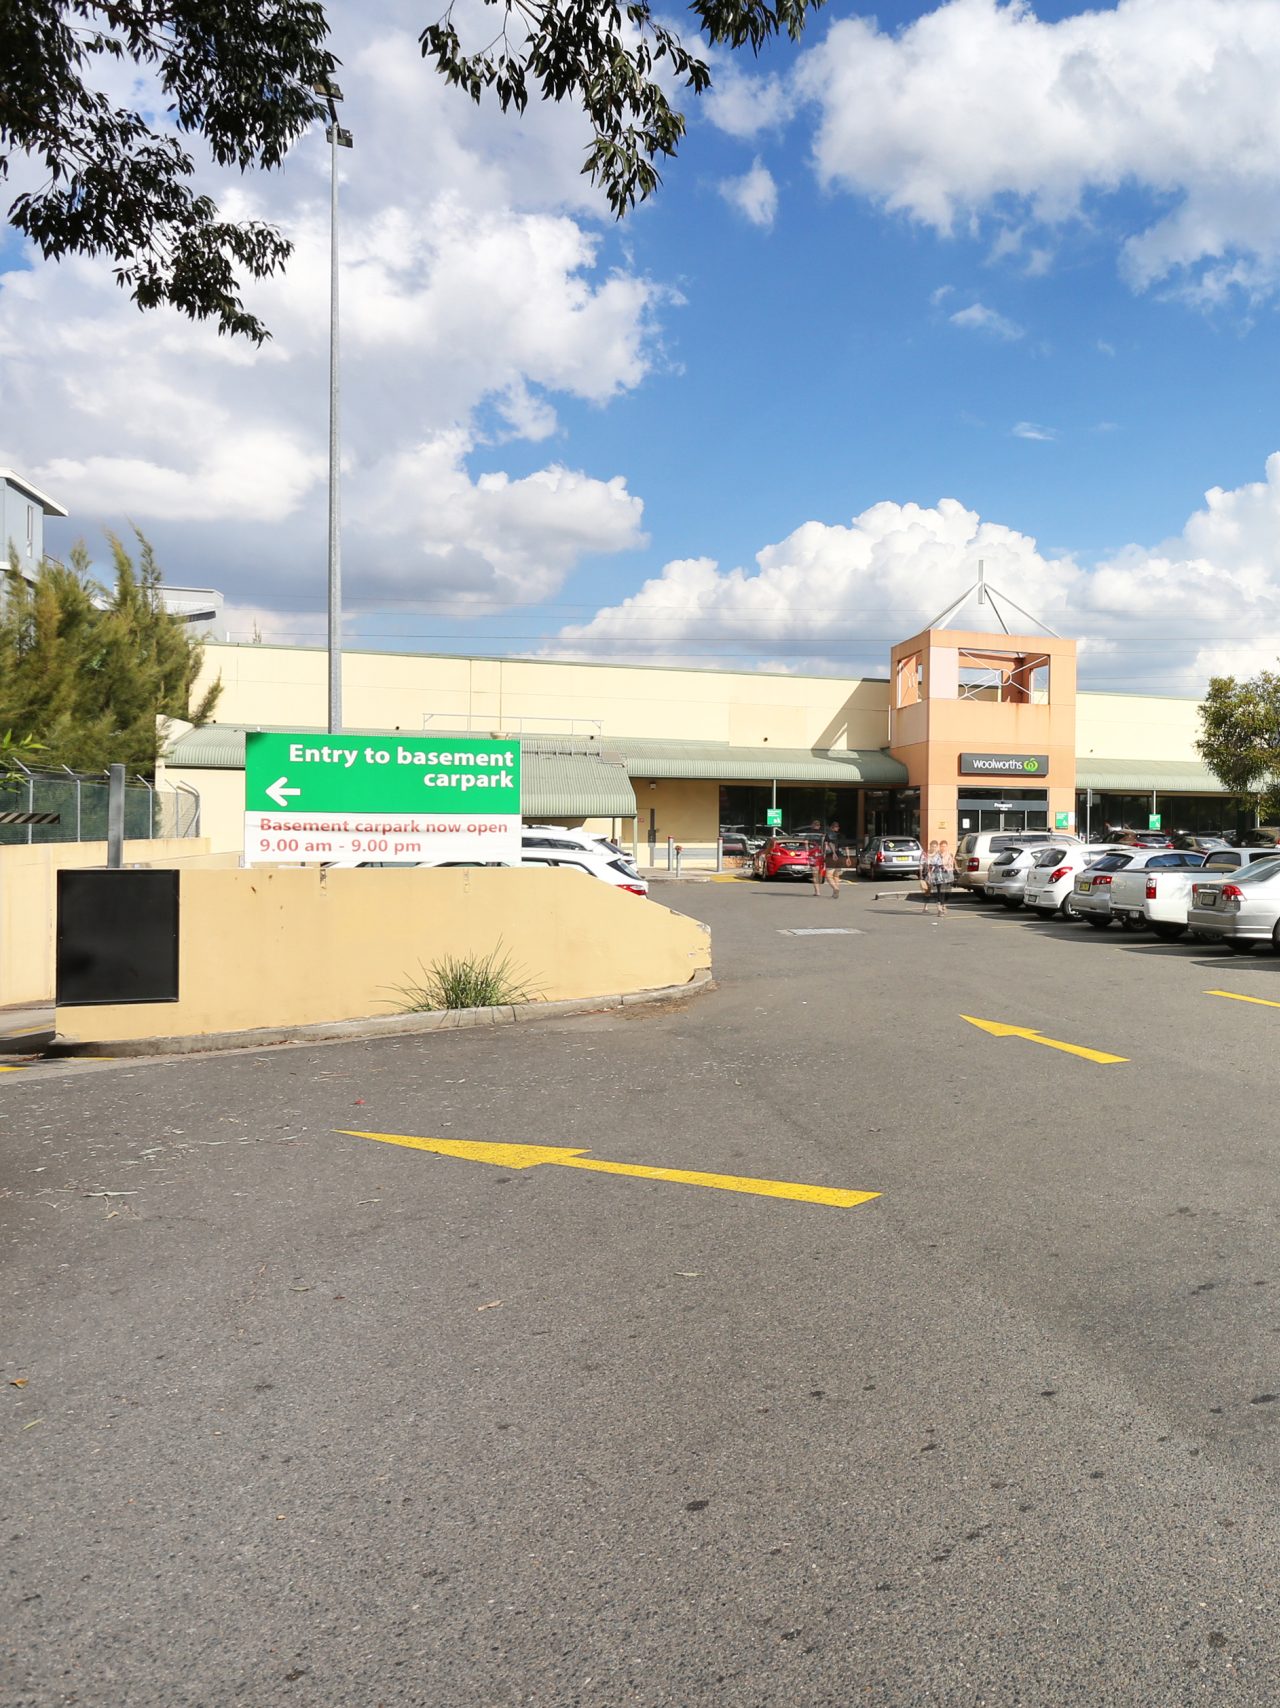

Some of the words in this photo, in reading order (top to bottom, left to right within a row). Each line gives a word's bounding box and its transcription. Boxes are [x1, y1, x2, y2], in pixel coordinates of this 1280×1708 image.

[289, 744, 358, 767] Entry
[365, 747, 390, 764] to
[397, 747, 514, 767] basement
[973, 758, 1022, 770] Woolworths
[423, 770, 514, 791] carpark
[260, 818, 349, 832] Basement
[355, 819, 420, 835] carpark
[426, 822, 461, 833] now
[466, 822, 508, 836] open
[260, 839, 299, 852] 9.00
[304, 842, 332, 852] am
[351, 839, 388, 852] 9.00
[394, 841, 421, 855] pm
